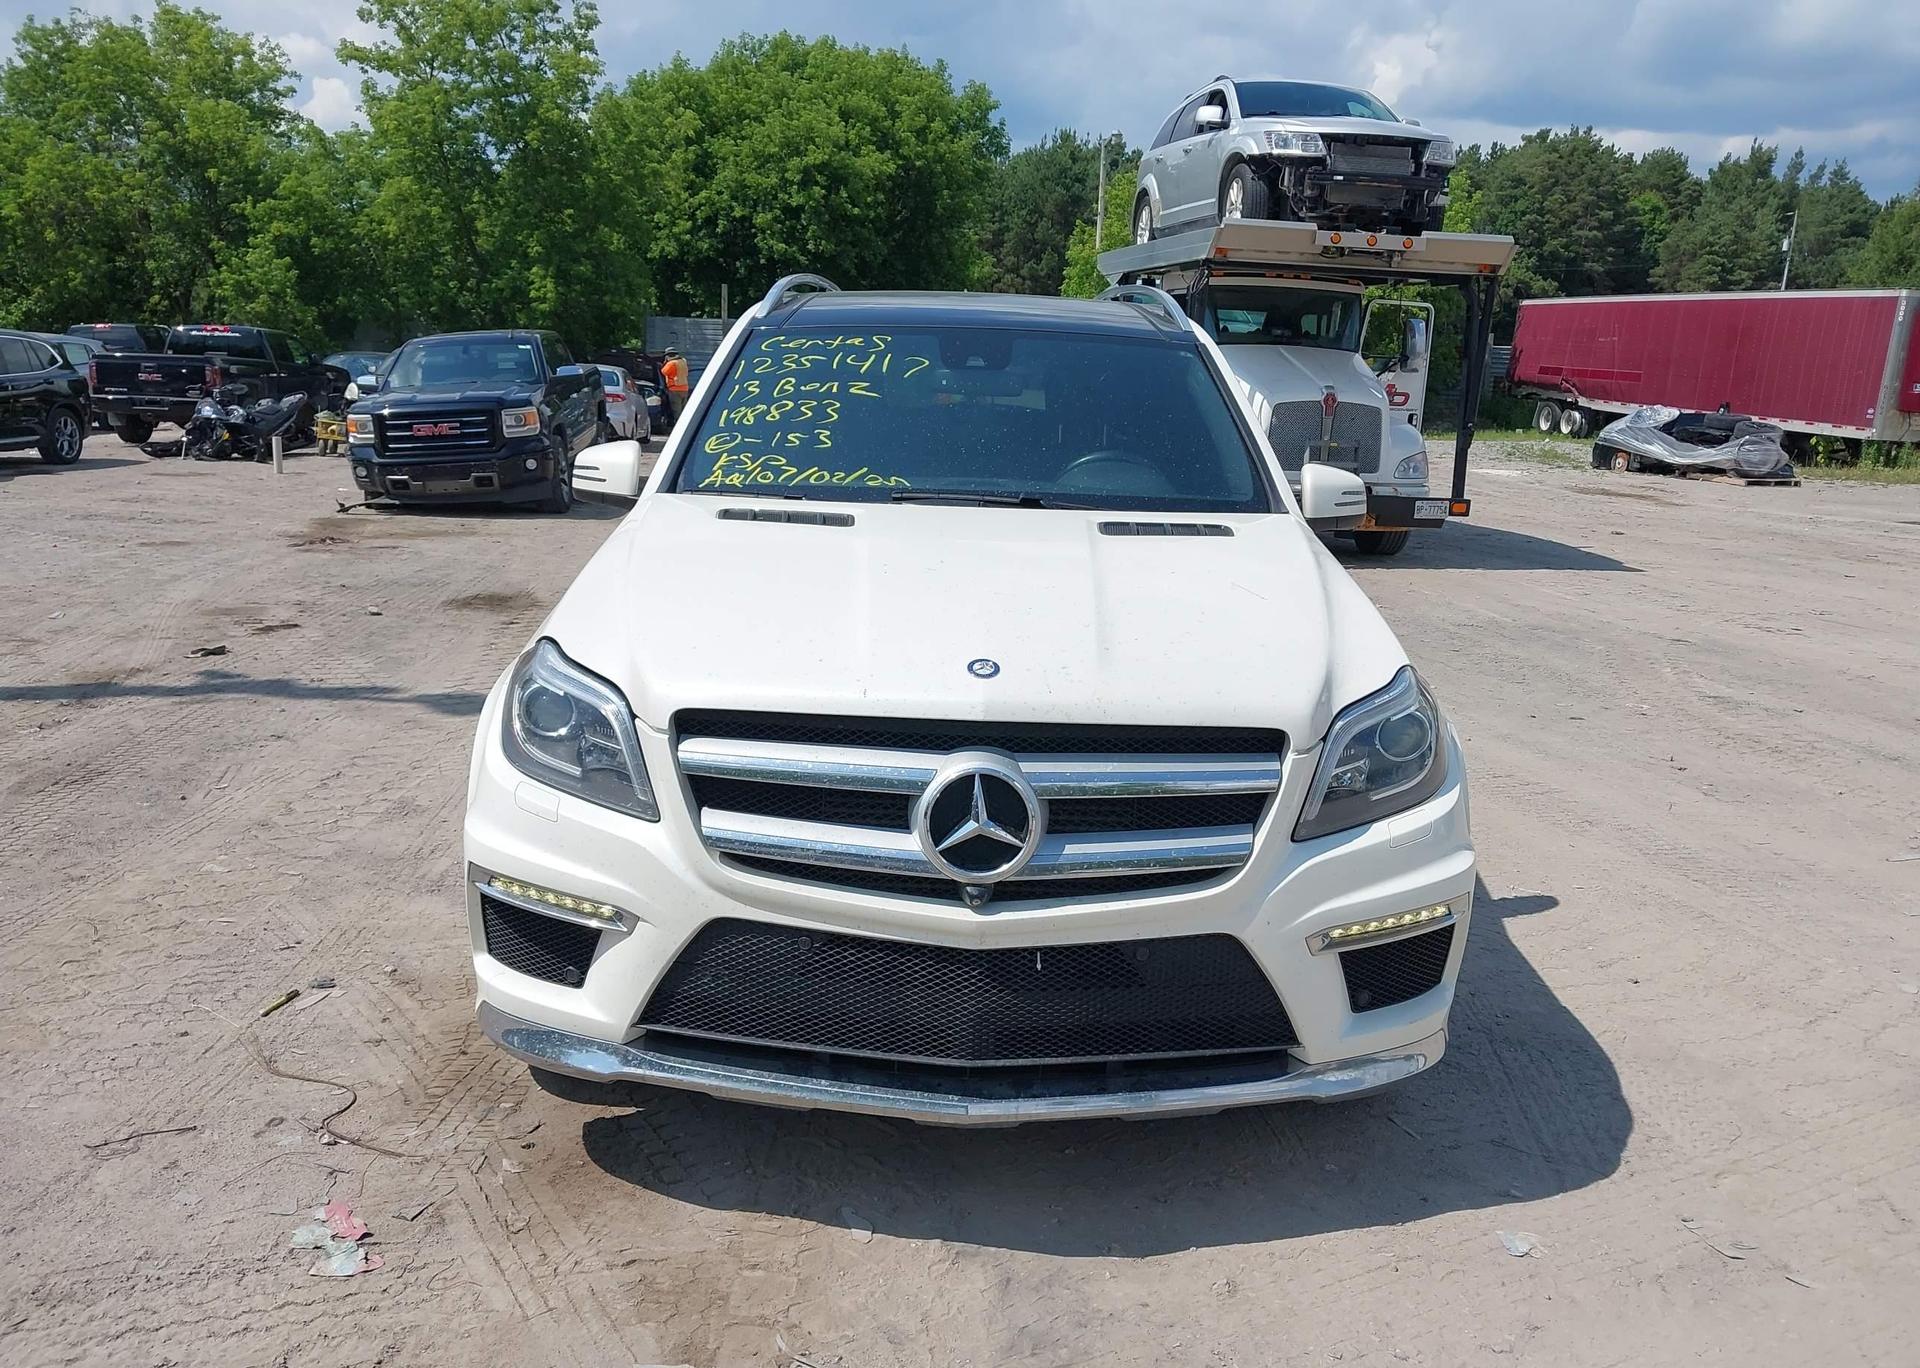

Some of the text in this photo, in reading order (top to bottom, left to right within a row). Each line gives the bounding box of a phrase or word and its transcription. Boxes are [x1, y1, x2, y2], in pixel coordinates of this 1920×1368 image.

[138, 372, 163, 381] GMC
[728, 380, 761, 402] 13
[412, 423, 461, 437] GMC
